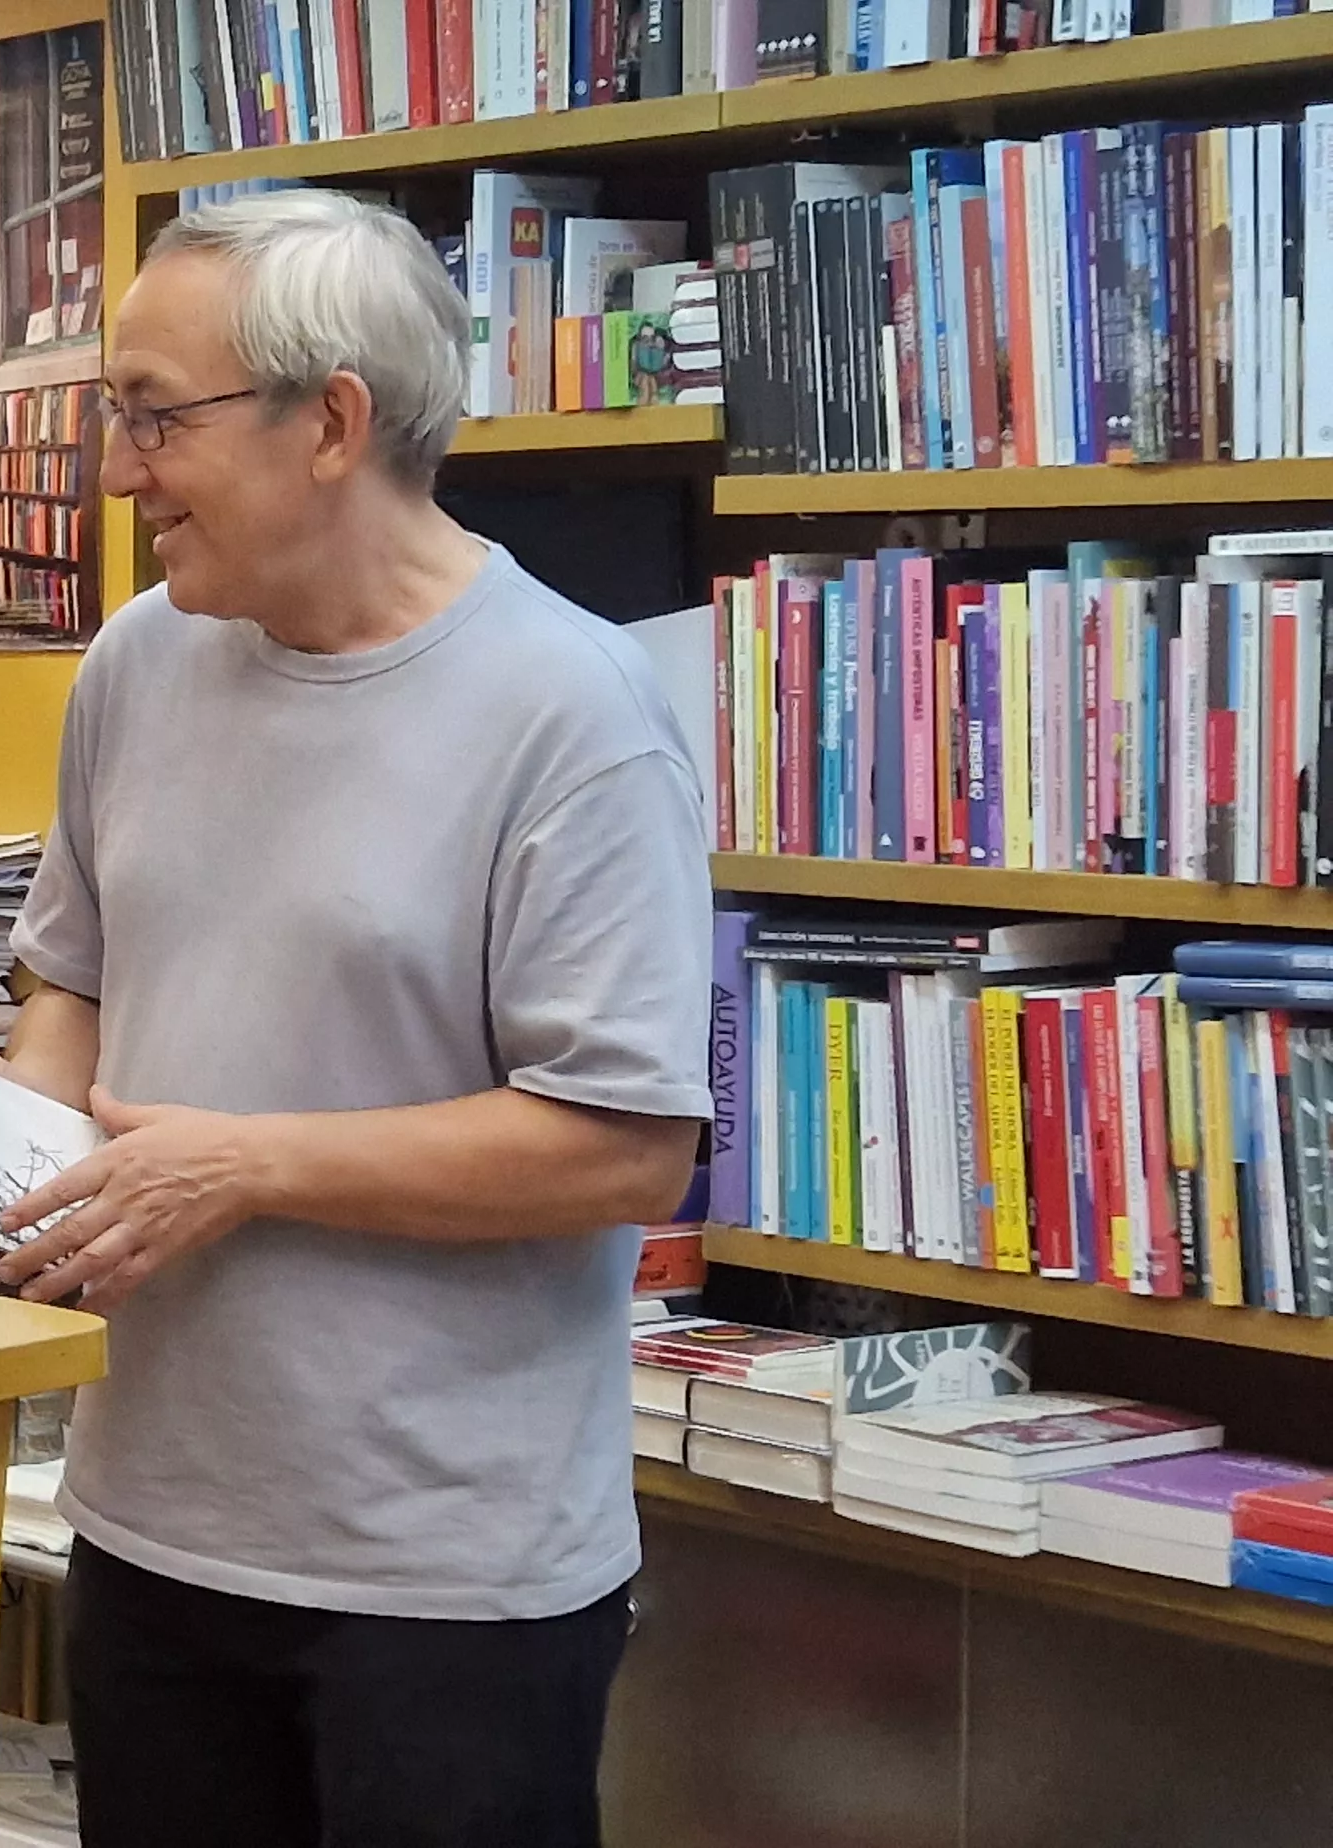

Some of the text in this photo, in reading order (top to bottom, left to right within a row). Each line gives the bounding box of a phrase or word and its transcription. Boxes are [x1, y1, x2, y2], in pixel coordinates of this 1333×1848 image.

[713, 983, 737, 1156] AUTOAYUDA
[828, 1023, 843, 1083] DYER
[955, 1087, 974, 1200] WALKSCAPES
